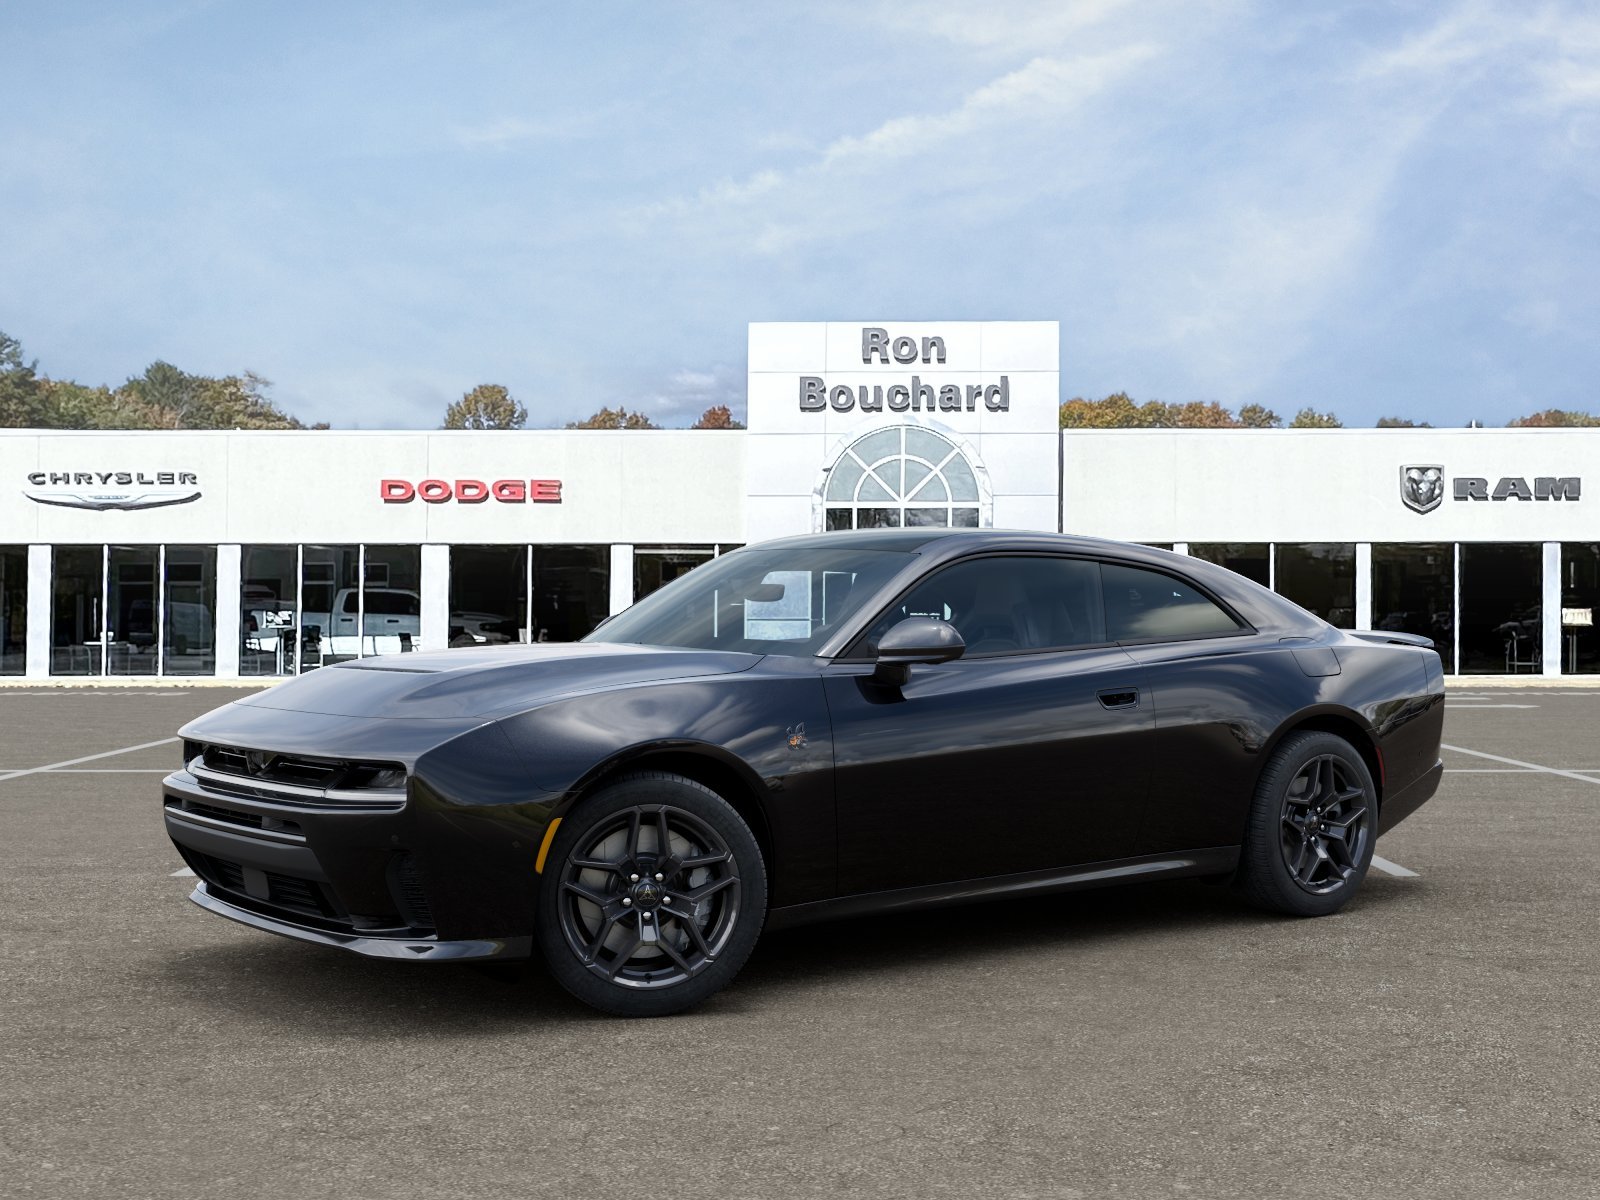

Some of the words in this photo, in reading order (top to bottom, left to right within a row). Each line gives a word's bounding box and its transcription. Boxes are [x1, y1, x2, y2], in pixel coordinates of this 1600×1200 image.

[861, 327, 946, 364] Ron
[799, 375, 1010, 412] Bouchard
[27, 472, 198, 485] CHRYSLER
[1453, 477, 1581, 501] RAM
[381, 480, 562, 504] DODGE
